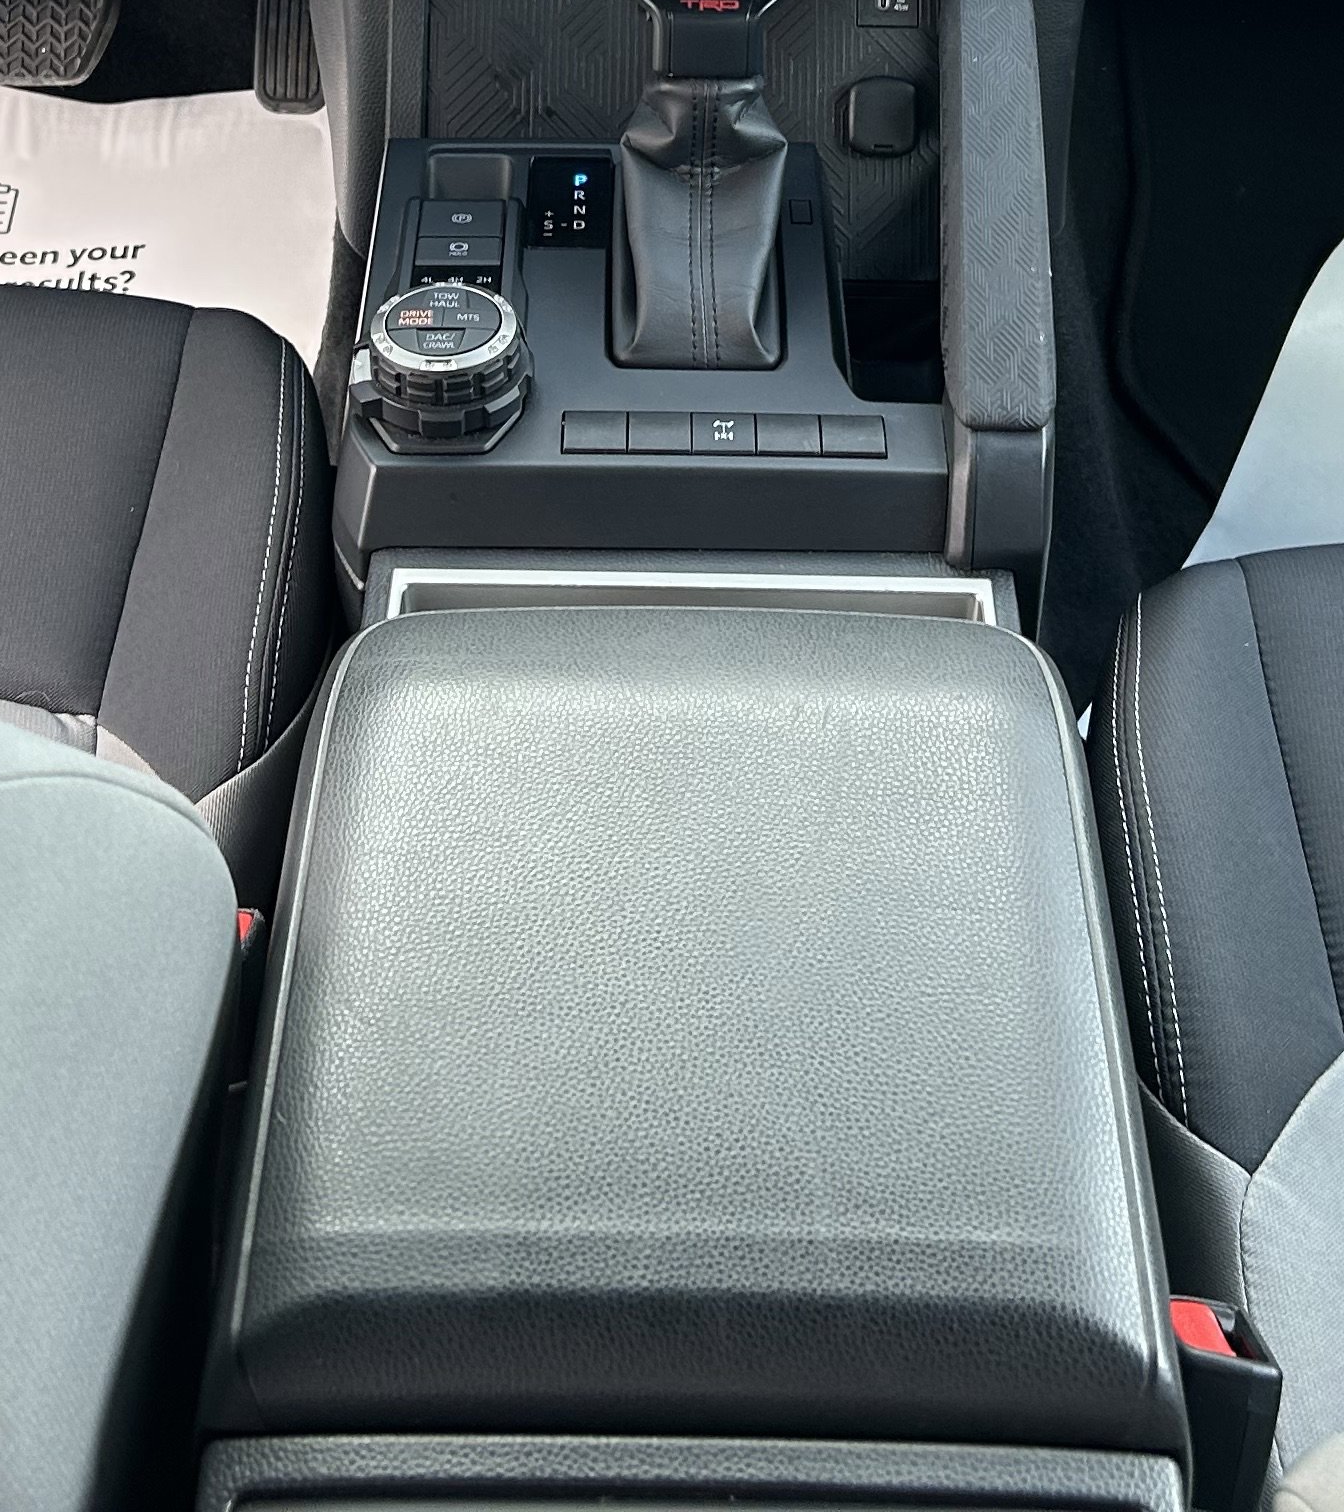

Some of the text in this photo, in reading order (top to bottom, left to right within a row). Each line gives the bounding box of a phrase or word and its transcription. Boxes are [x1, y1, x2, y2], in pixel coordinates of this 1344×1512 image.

[575, 174, 588, 186] P
[574, 190, 586, 201] R
[574, 205, 586, 215] N
[543, 220, 553, 230] S
[573, 220, 586, 230] D
[66, 241, 147, 268] your
[434, 292, 460, 300] TOW
[399, 309, 433, 318] DRIVE
[457, 313, 480, 322] MTS
[398, 317, 433, 326] MODE
